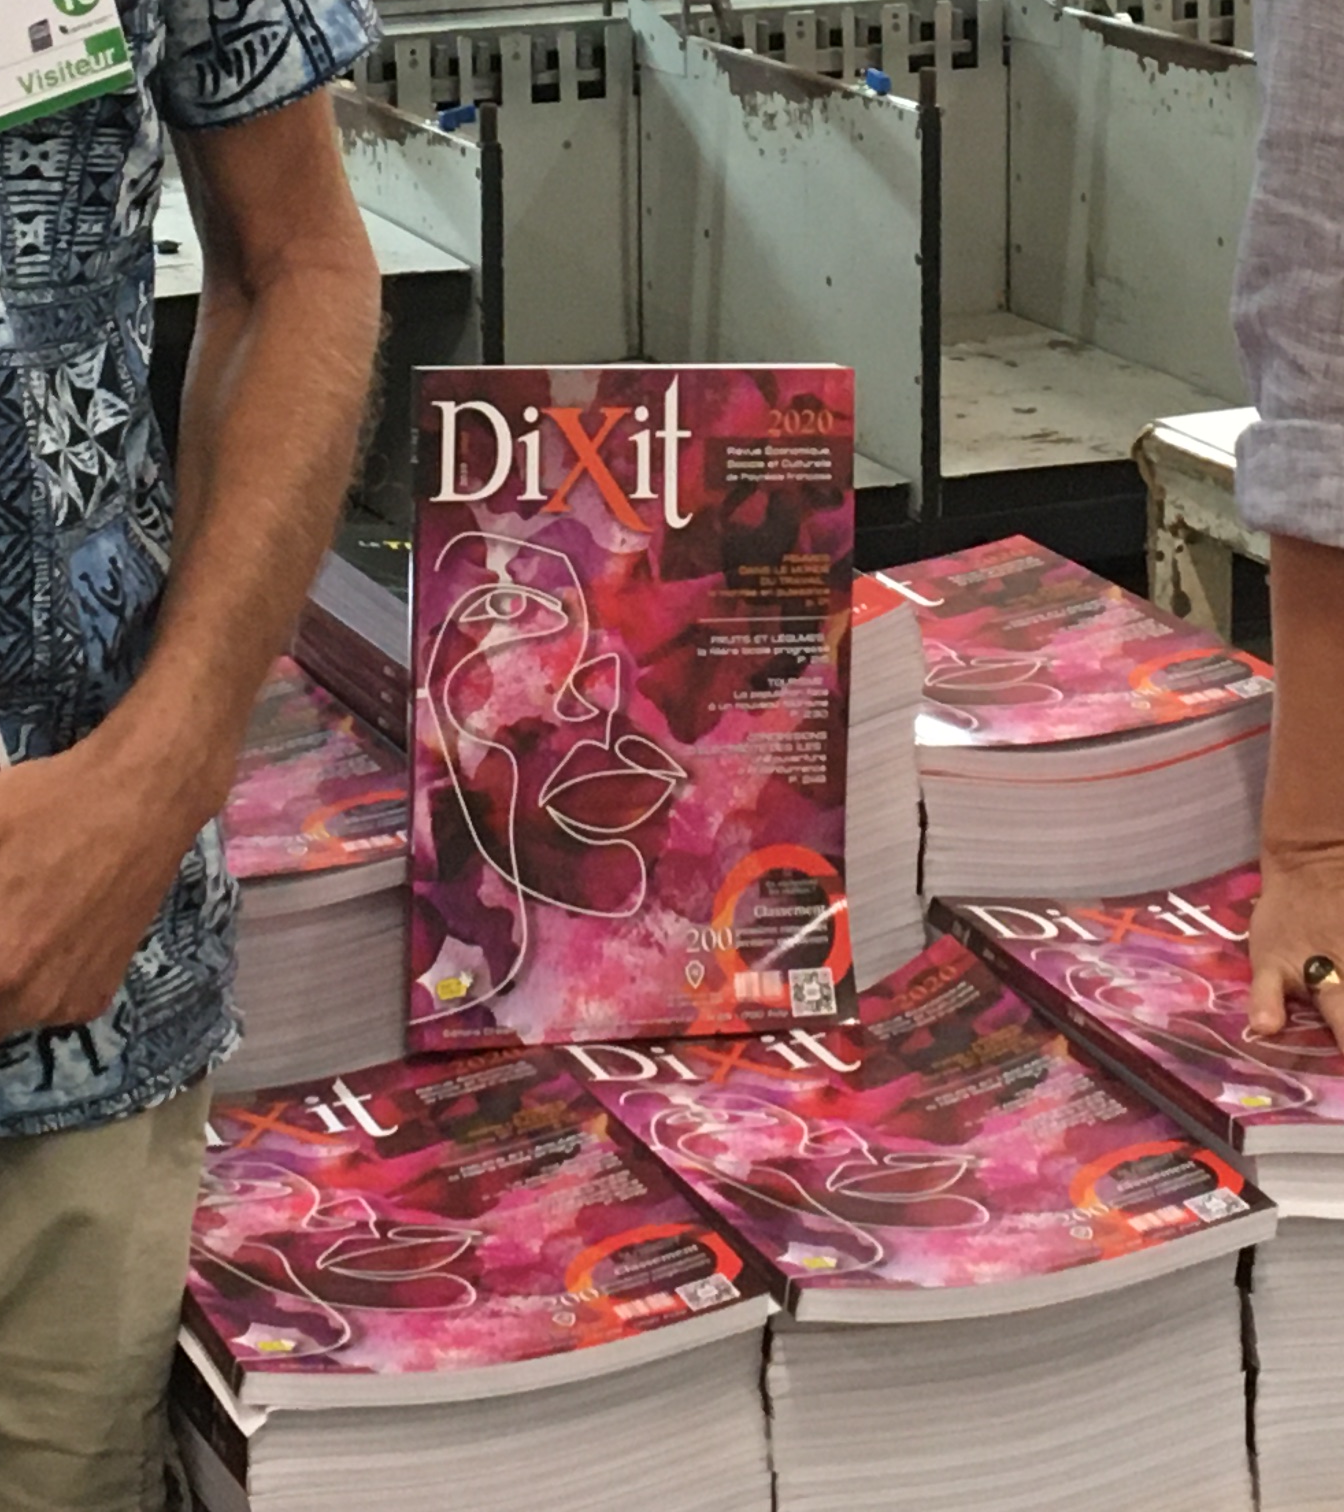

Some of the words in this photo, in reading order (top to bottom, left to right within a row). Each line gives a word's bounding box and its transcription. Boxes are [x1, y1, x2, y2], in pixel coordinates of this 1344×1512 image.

[16, 46, 116, 94] Visiteur
[767, 409, 834, 438] 2020
[685, 926, 733, 953] 200
